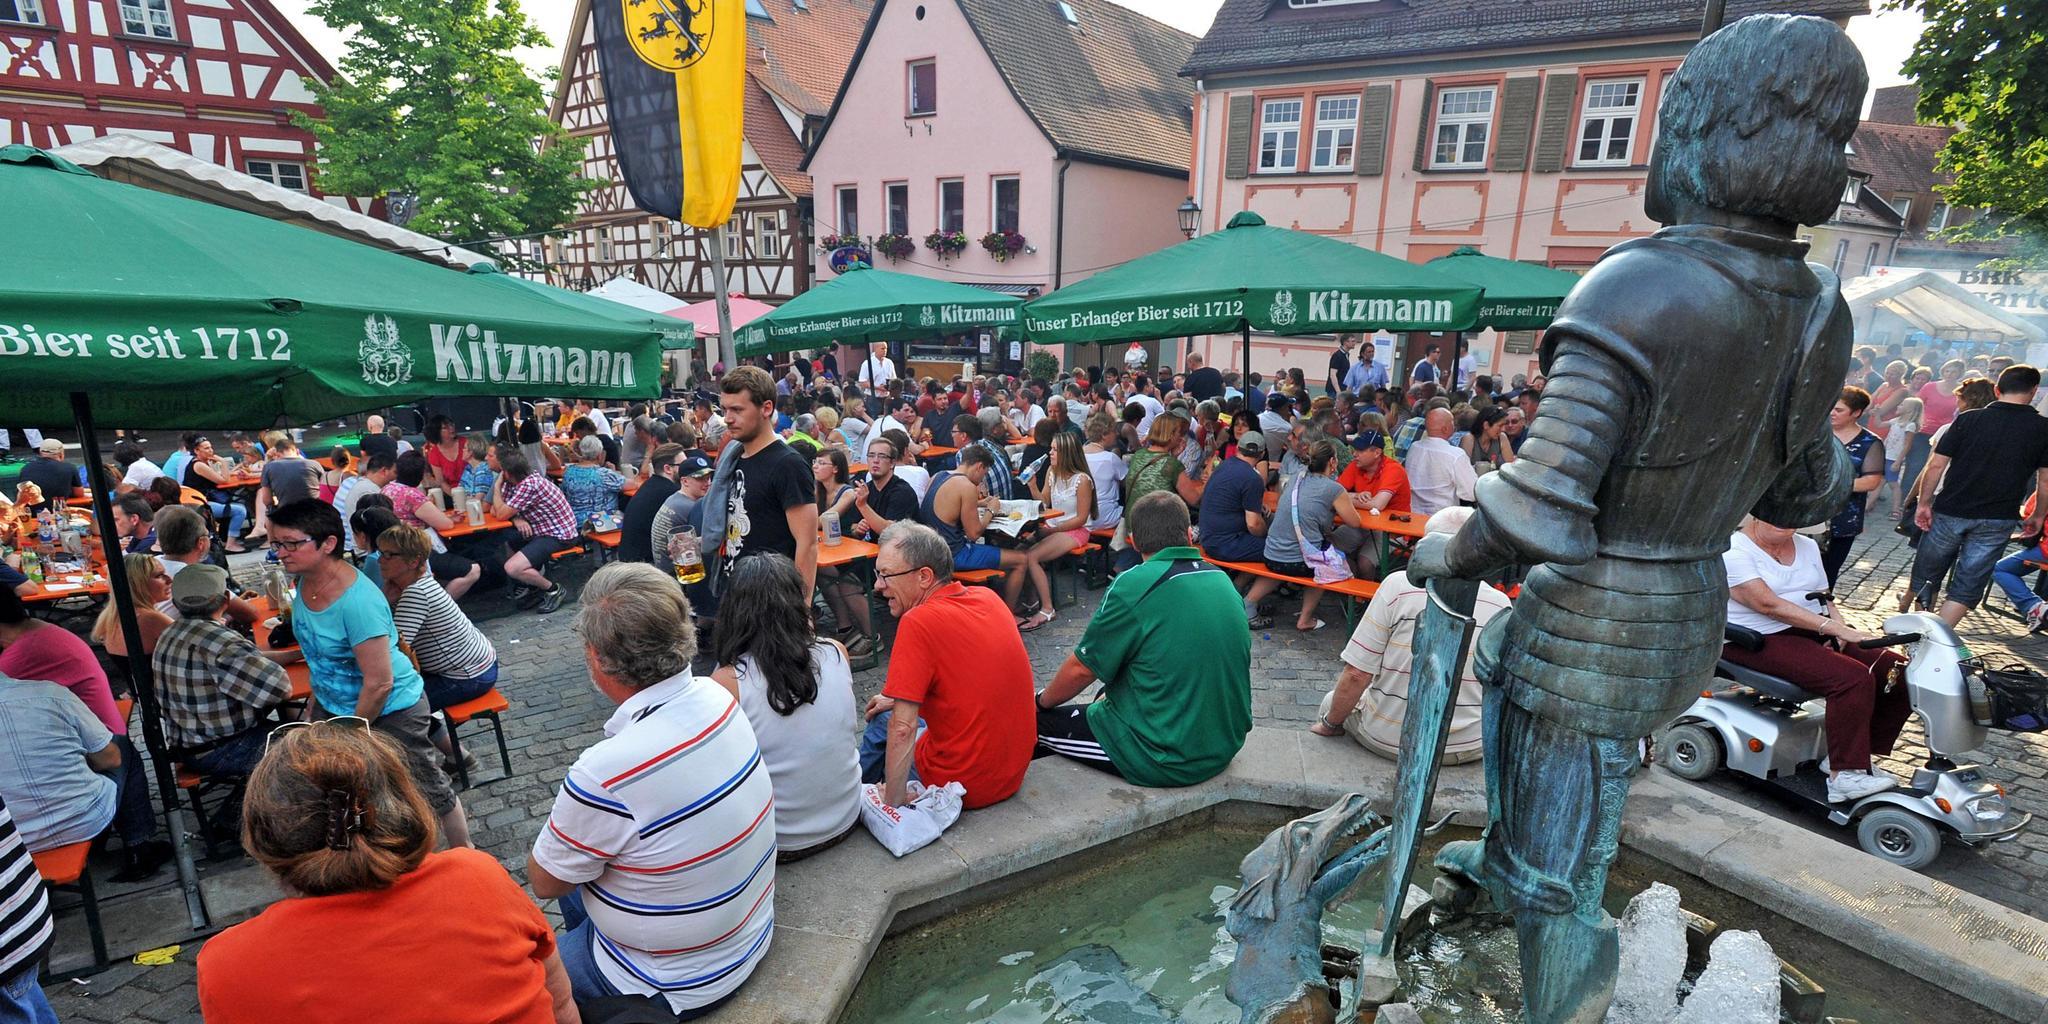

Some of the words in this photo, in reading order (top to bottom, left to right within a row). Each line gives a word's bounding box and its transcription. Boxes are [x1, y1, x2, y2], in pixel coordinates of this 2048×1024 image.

[1957, 270, 2024, 285] BRK
[941, 304, 1016, 323] Kitzmann
[1025, 318, 1067, 332] Unser
[1070, 310, 1135, 327] Erlanger
[1137, 305, 1169, 321] Bier
[1172, 303, 1200, 319] seit
[1204, 300, 1243, 317] 1712
[1308, 290, 1453, 323] Kitzmann
[1495, 304, 1516, 316] Bier
[1516, 305, 1533, 317] seit
[769, 325, 799, 336] Unser
[799, 320, 841, 333] Erlanger
[841, 316, 861, 328] Bier
[862, 314, 879, 325] seit
[881, 312, 903, 324] 1712
[0, 323, 94, 358] Bier
[106, 326, 187, 359] seit
[191, 327, 291, 361] 1712
[429, 323, 637, 388] Kitzmann
